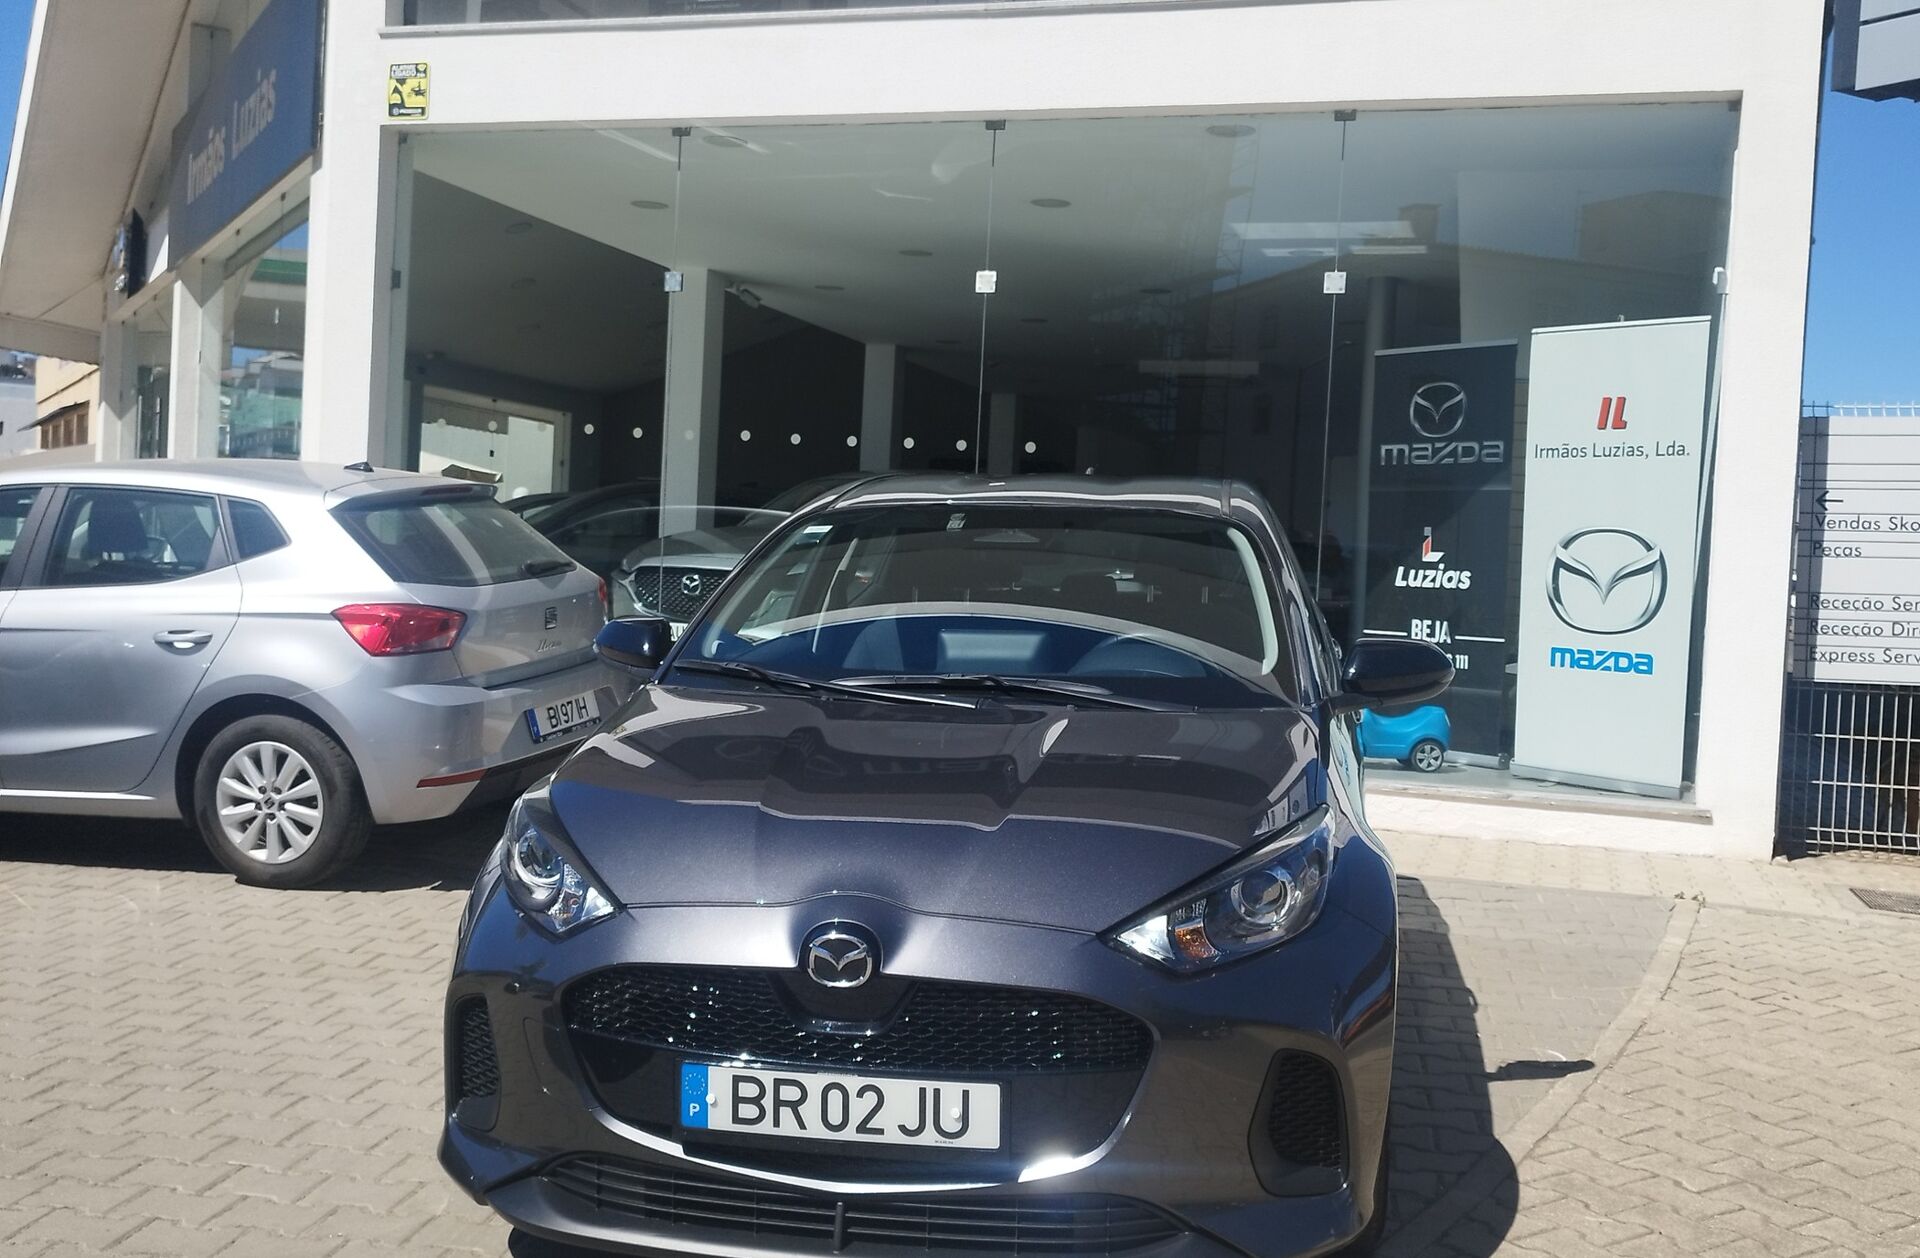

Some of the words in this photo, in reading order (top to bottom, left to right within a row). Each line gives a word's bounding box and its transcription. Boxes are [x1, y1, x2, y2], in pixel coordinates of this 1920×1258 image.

[232, 69, 277, 161] Luzias
[1534, 443, 1588, 459] Irmãos
[1592, 442, 1650, 460] Luzias,
[1655, 440, 1691, 457] Lda.
[1815, 514, 1881, 530] Vendas
[1812, 542, 1862, 558] Peças
[1395, 563, 1472, 590] Luzias
[1810, 594, 1884, 611] Receção
[1411, 619, 1452, 644] BEJA
[1810, 620, 1884, 637] Receção
[1809, 647, 1875, 664] Express
[560, 701, 574, 724] 97
[690, 1103, 700, 1117] P
[731, 1074, 809, 1131] BR
[820, 1081, 885, 1136] 02
[897, 1086, 970, 1140] JU
